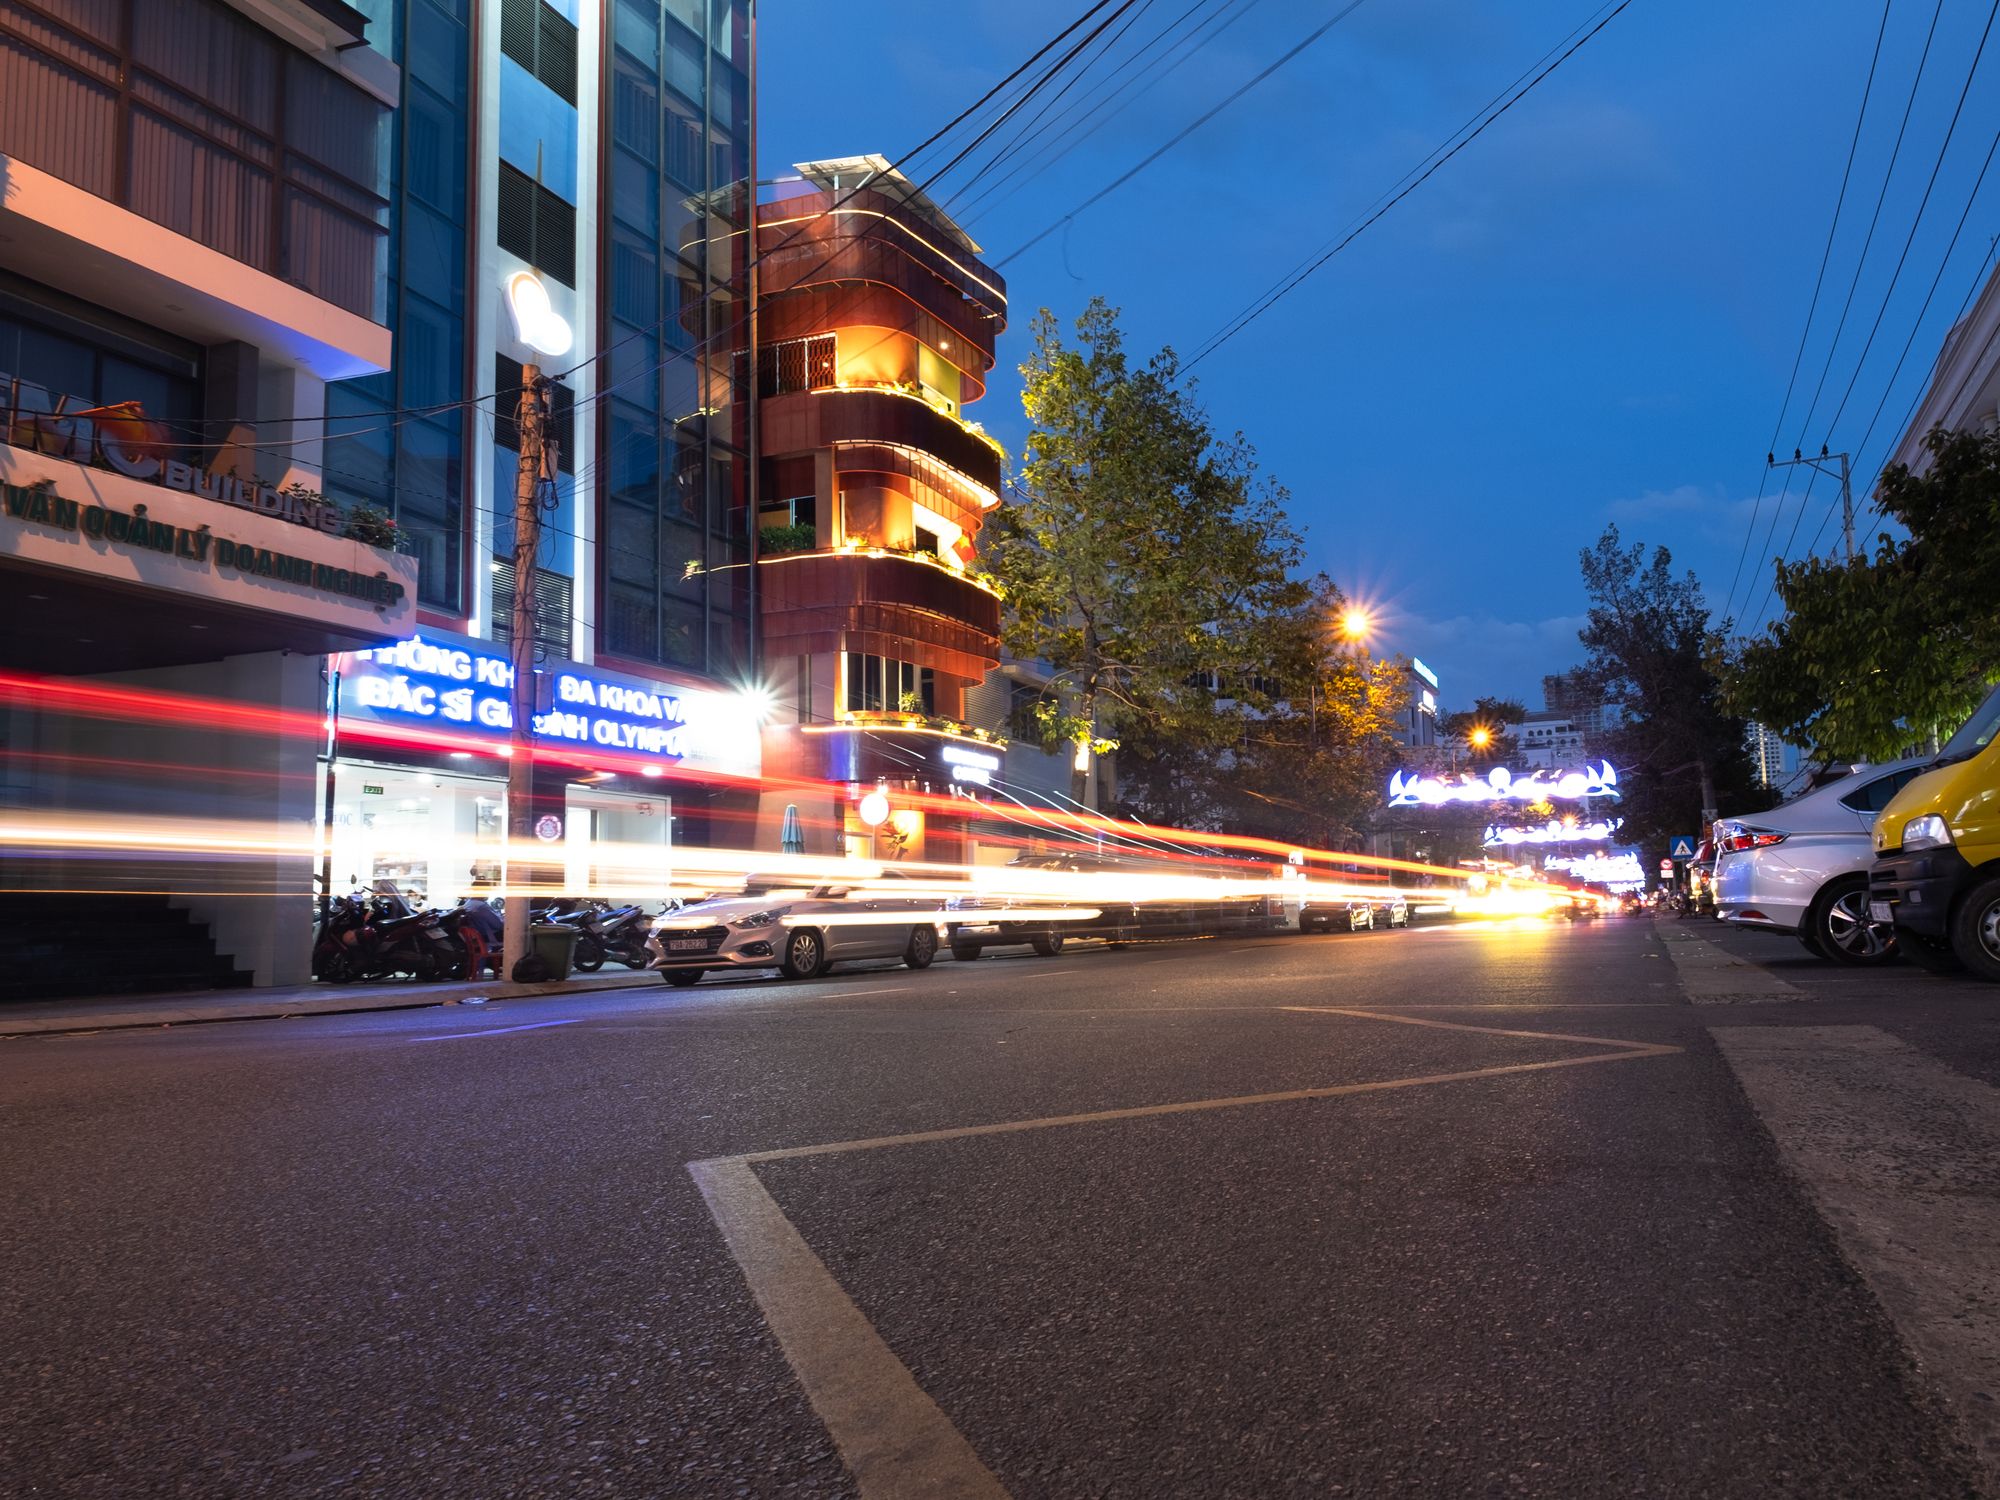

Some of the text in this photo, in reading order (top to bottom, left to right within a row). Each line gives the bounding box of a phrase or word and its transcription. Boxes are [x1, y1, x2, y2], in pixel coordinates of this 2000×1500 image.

[81, 503, 175, 554] QUẢN
[175, 524, 214, 562] LÝ
[213, 536, 314, 589] DOANH
[313, 562, 405, 614] NGHIỆP
[356, 635, 472, 680] HÒNG
[560, 675, 597, 706] ĐA
[600, 684, 663, 719] KHOA
[358, 675, 436, 716] BÁC
